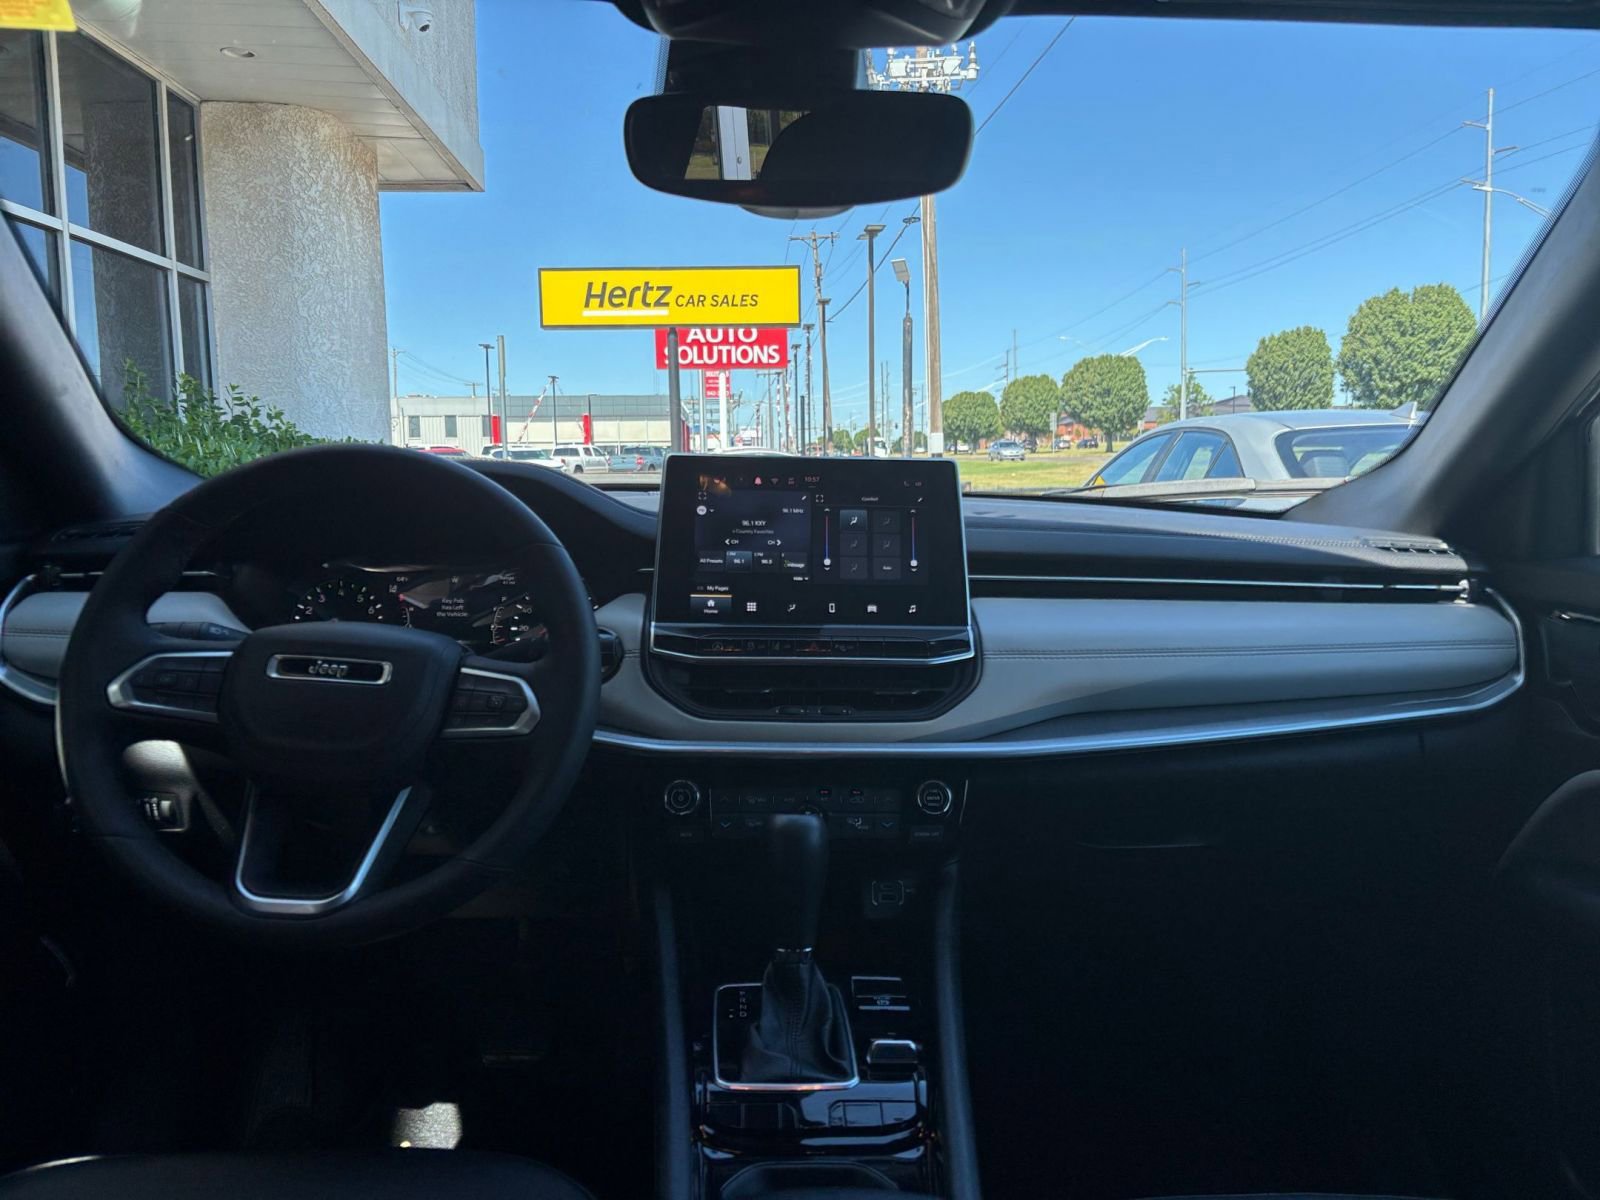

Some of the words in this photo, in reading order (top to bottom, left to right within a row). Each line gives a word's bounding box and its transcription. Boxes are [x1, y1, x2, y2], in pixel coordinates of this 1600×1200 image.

[583, 281, 673, 308] Hertz
[675, 295, 706, 308] CAR
[710, 294, 759, 307] SALES
[686, 328, 758, 343] AUTO
[318, 594, 326, 603] 3
[356, 594, 364, 603] 5
[305, 606, 313, 615] 2
[367, 606, 375, 615] 6
